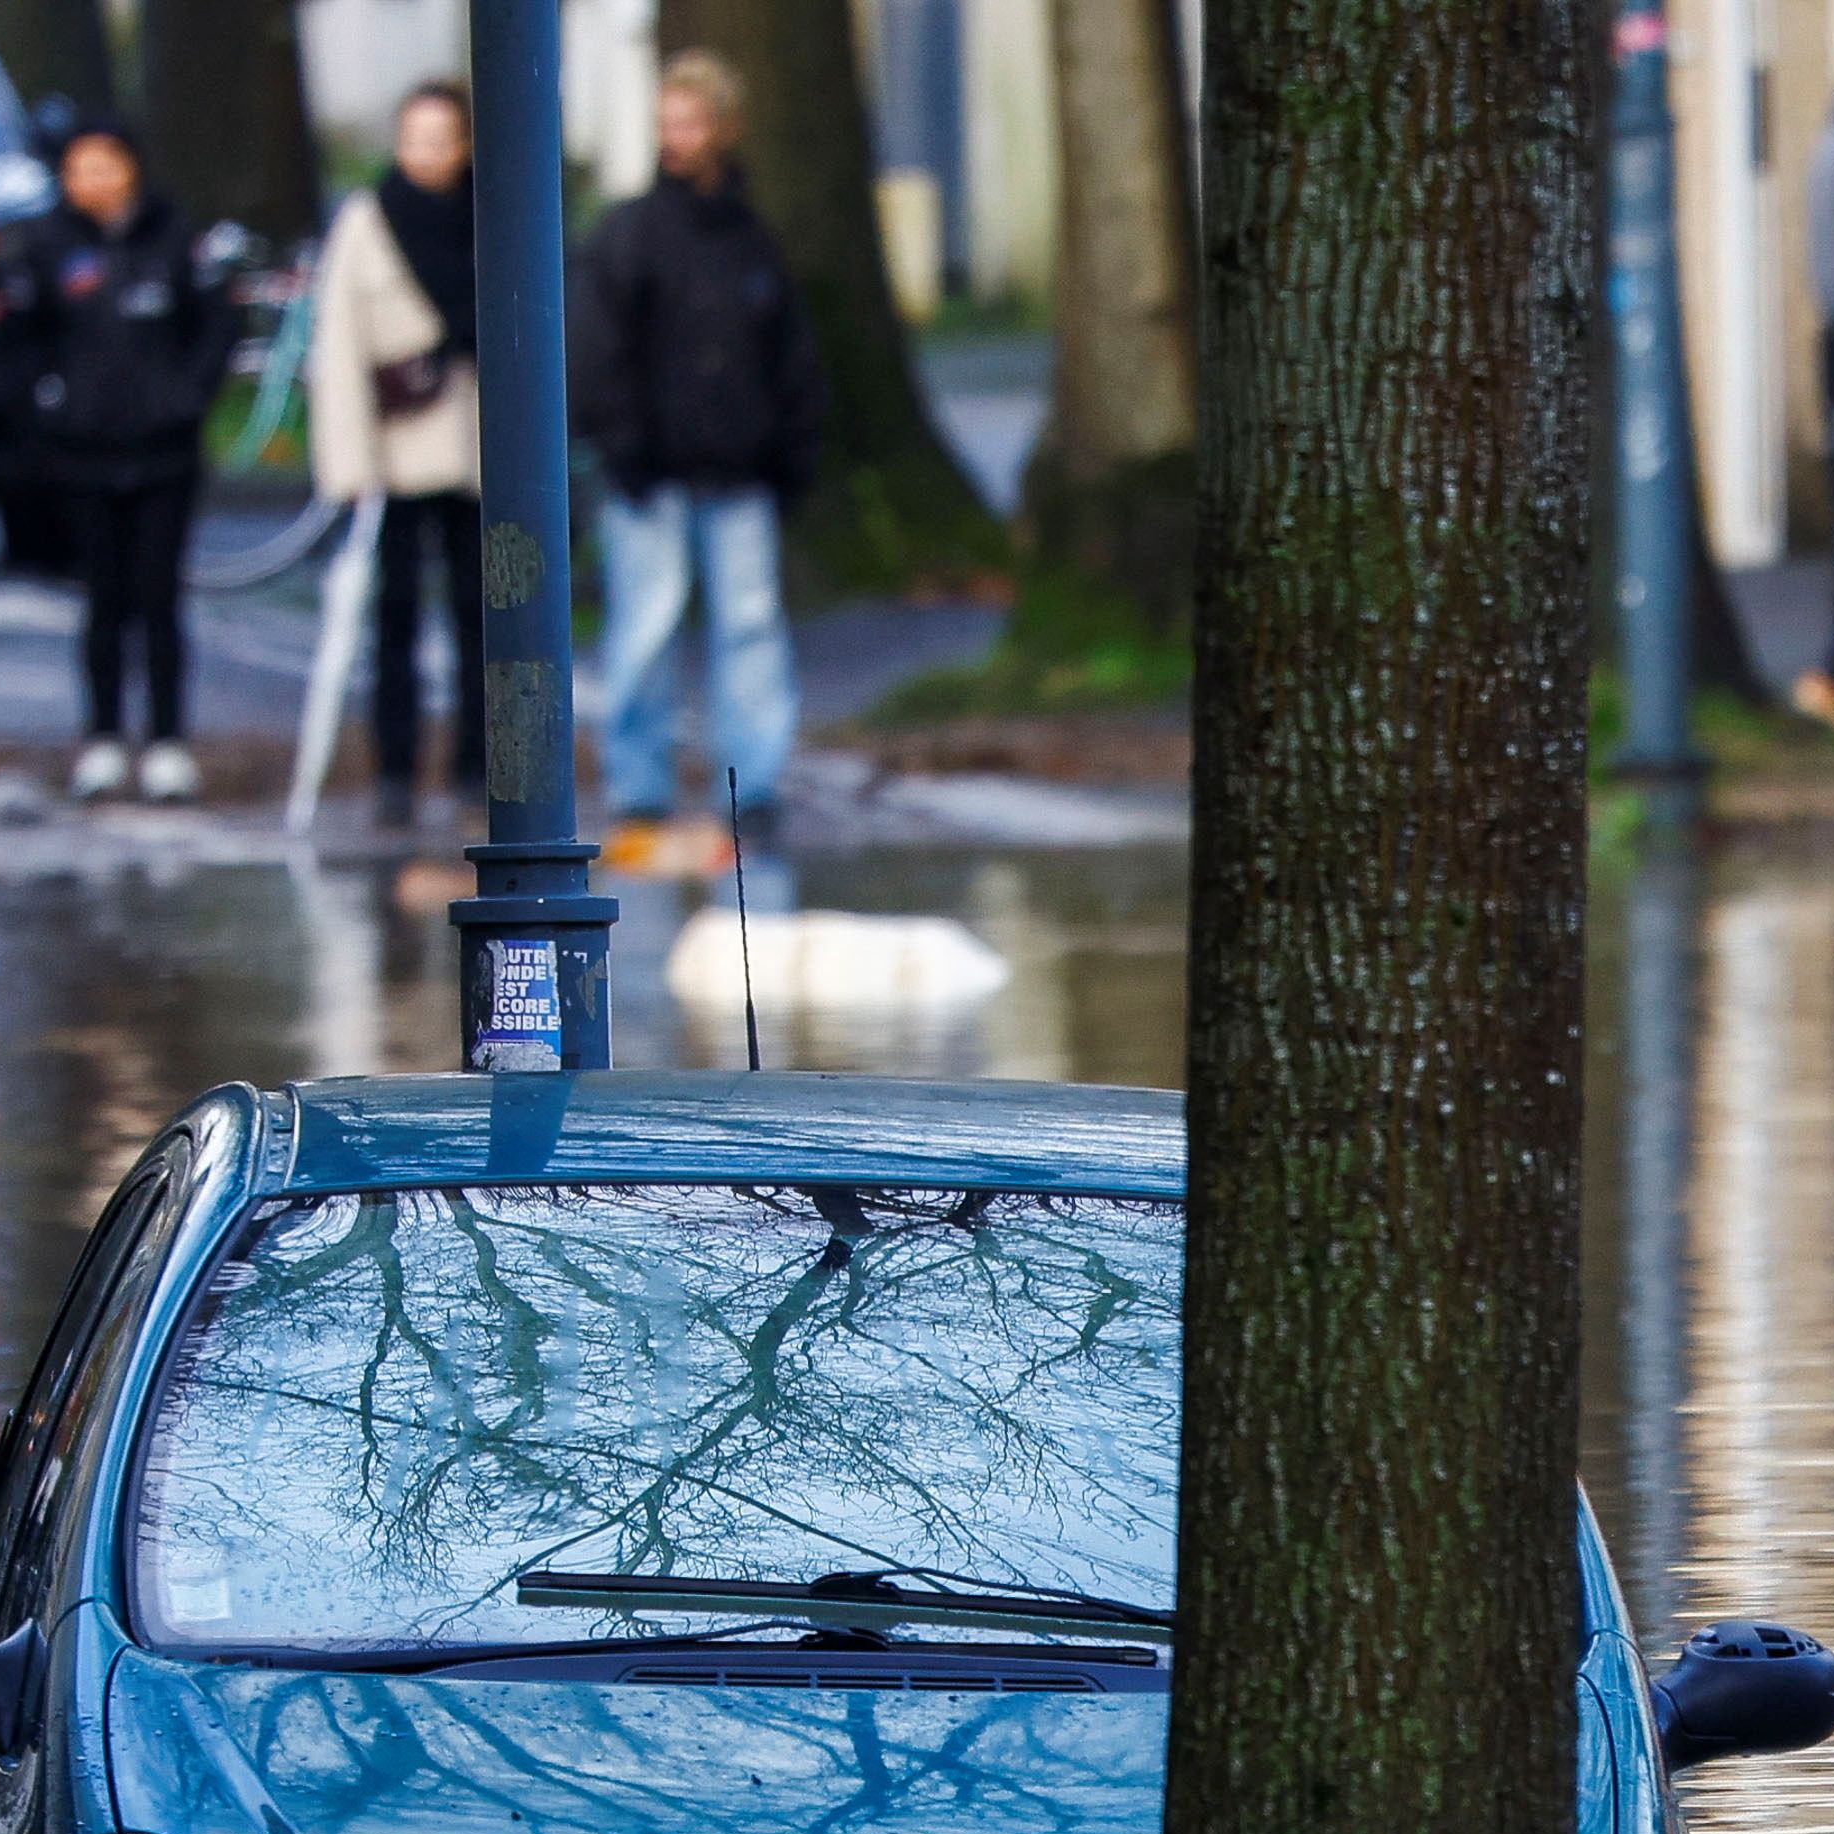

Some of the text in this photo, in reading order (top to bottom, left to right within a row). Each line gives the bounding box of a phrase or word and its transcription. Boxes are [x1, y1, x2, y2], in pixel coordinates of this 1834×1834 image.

[504, 948, 550, 964] UTR
[495, 998, 551, 1014] CORE
[491, 1014, 560, 1031] SSIBLE
